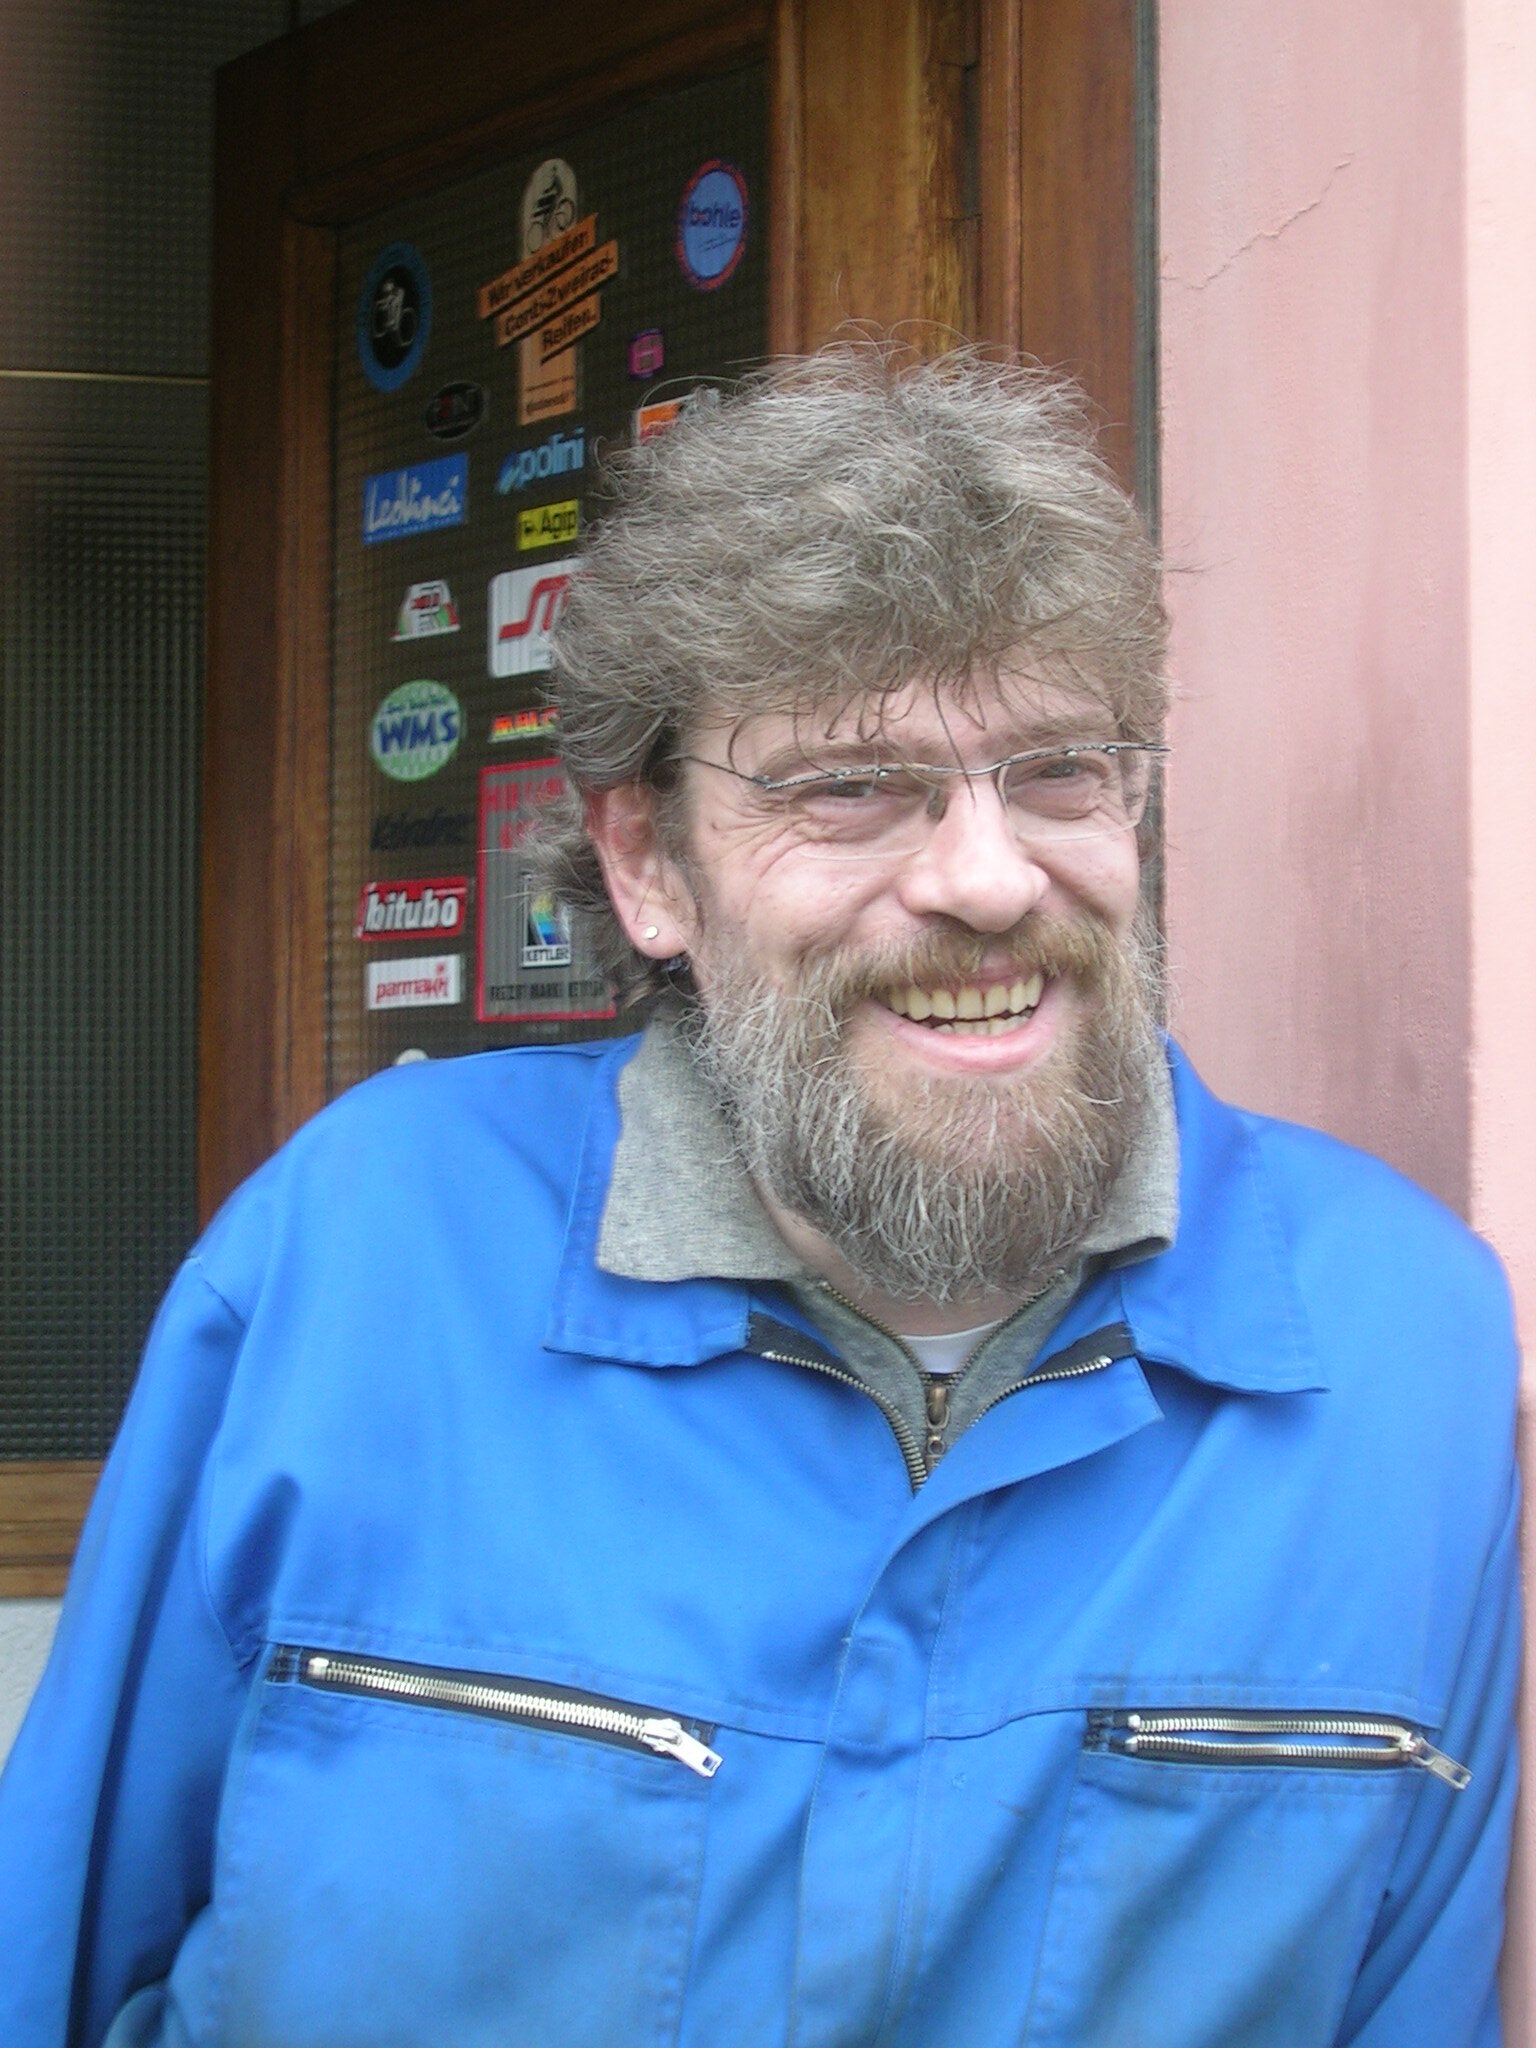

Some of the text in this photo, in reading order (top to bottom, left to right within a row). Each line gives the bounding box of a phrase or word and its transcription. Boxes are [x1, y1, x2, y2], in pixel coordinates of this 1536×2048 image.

[689, 201, 741, 228] bohle
[379, 711, 459, 755] WMS
[364, 886, 460, 933] bitubo
